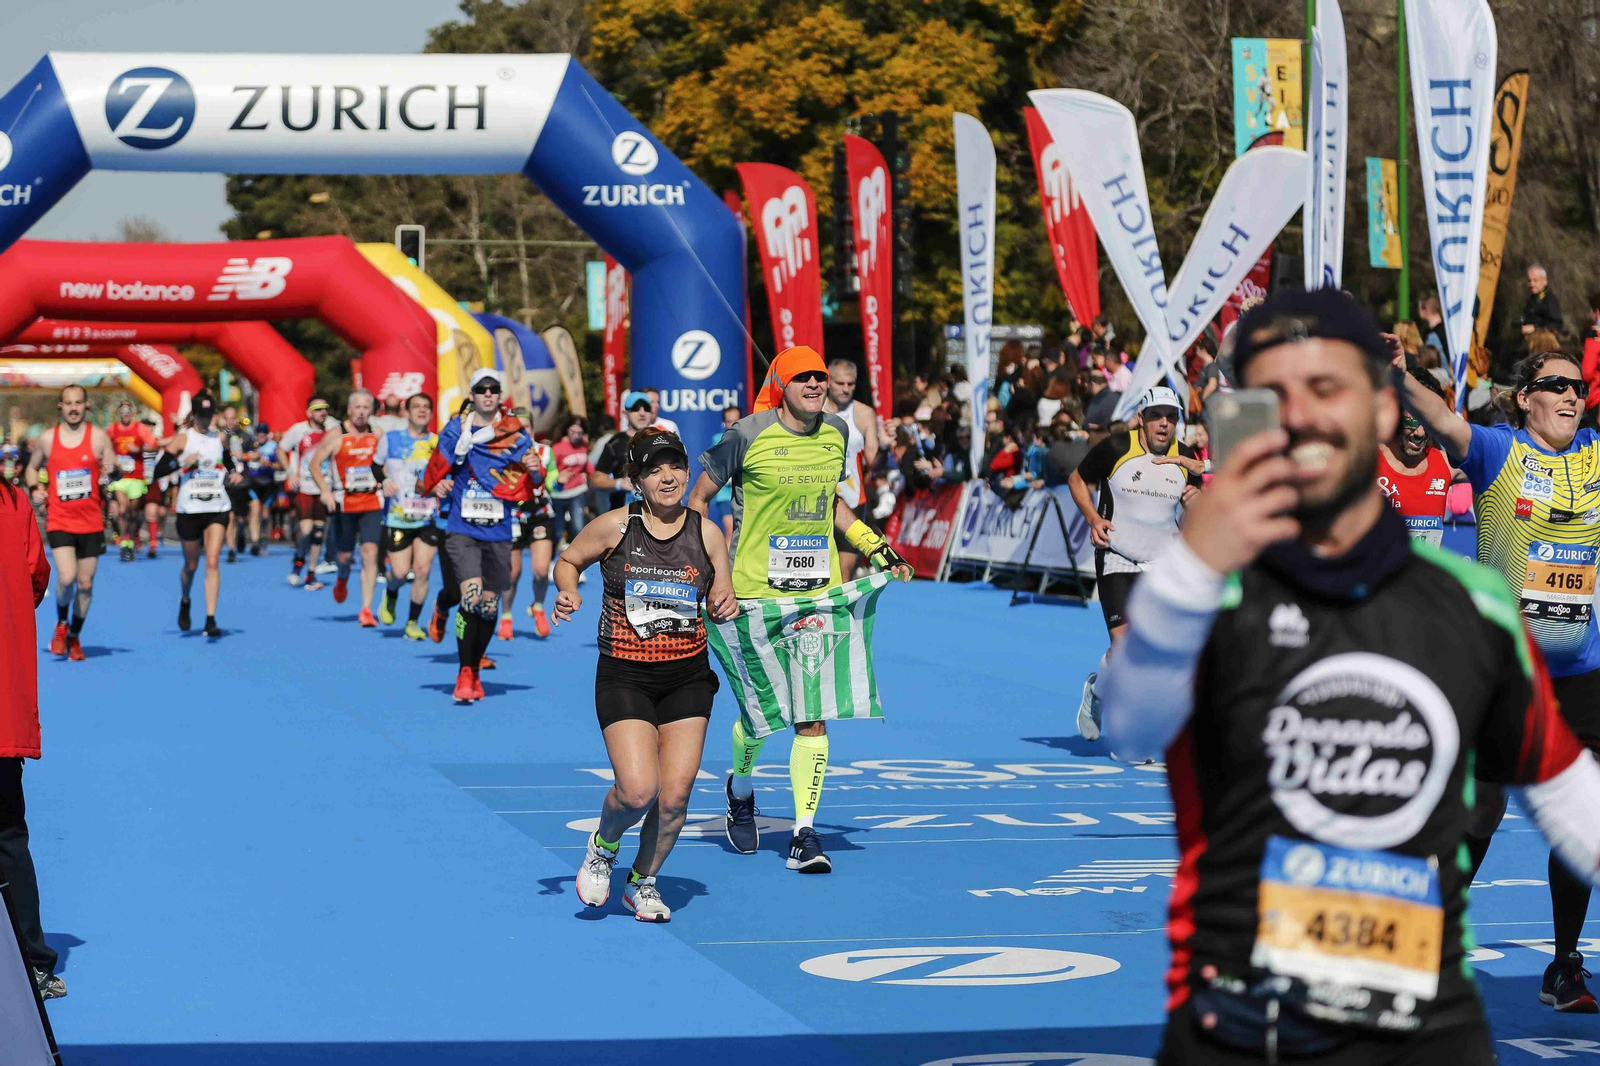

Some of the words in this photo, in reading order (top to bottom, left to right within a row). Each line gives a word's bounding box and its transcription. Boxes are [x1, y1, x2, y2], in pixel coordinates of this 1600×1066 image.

[228, 84, 487, 131] ZURICH
[582, 183, 685, 207] ZURICH
[61, 281, 103, 299] new
[107, 280, 195, 301] balance
[1169, 222, 1251, 342] URICH
[658, 389, 738, 412] URICH
[779, 475, 794, 484] DE
[798, 474, 837, 483] SEVILLA
[791, 539, 821, 547] ZURICH
[624, 563, 687, 577] Deporteando
[785, 556, 815, 568] 7680
[1546, 572, 1583, 590] 4165
[650, 585, 689, 598] ZURICH
[806, 753, 826, 811] Kalenji
[967, 885, 1148, 898] new
[1307, 911, 1397, 953] 4384
